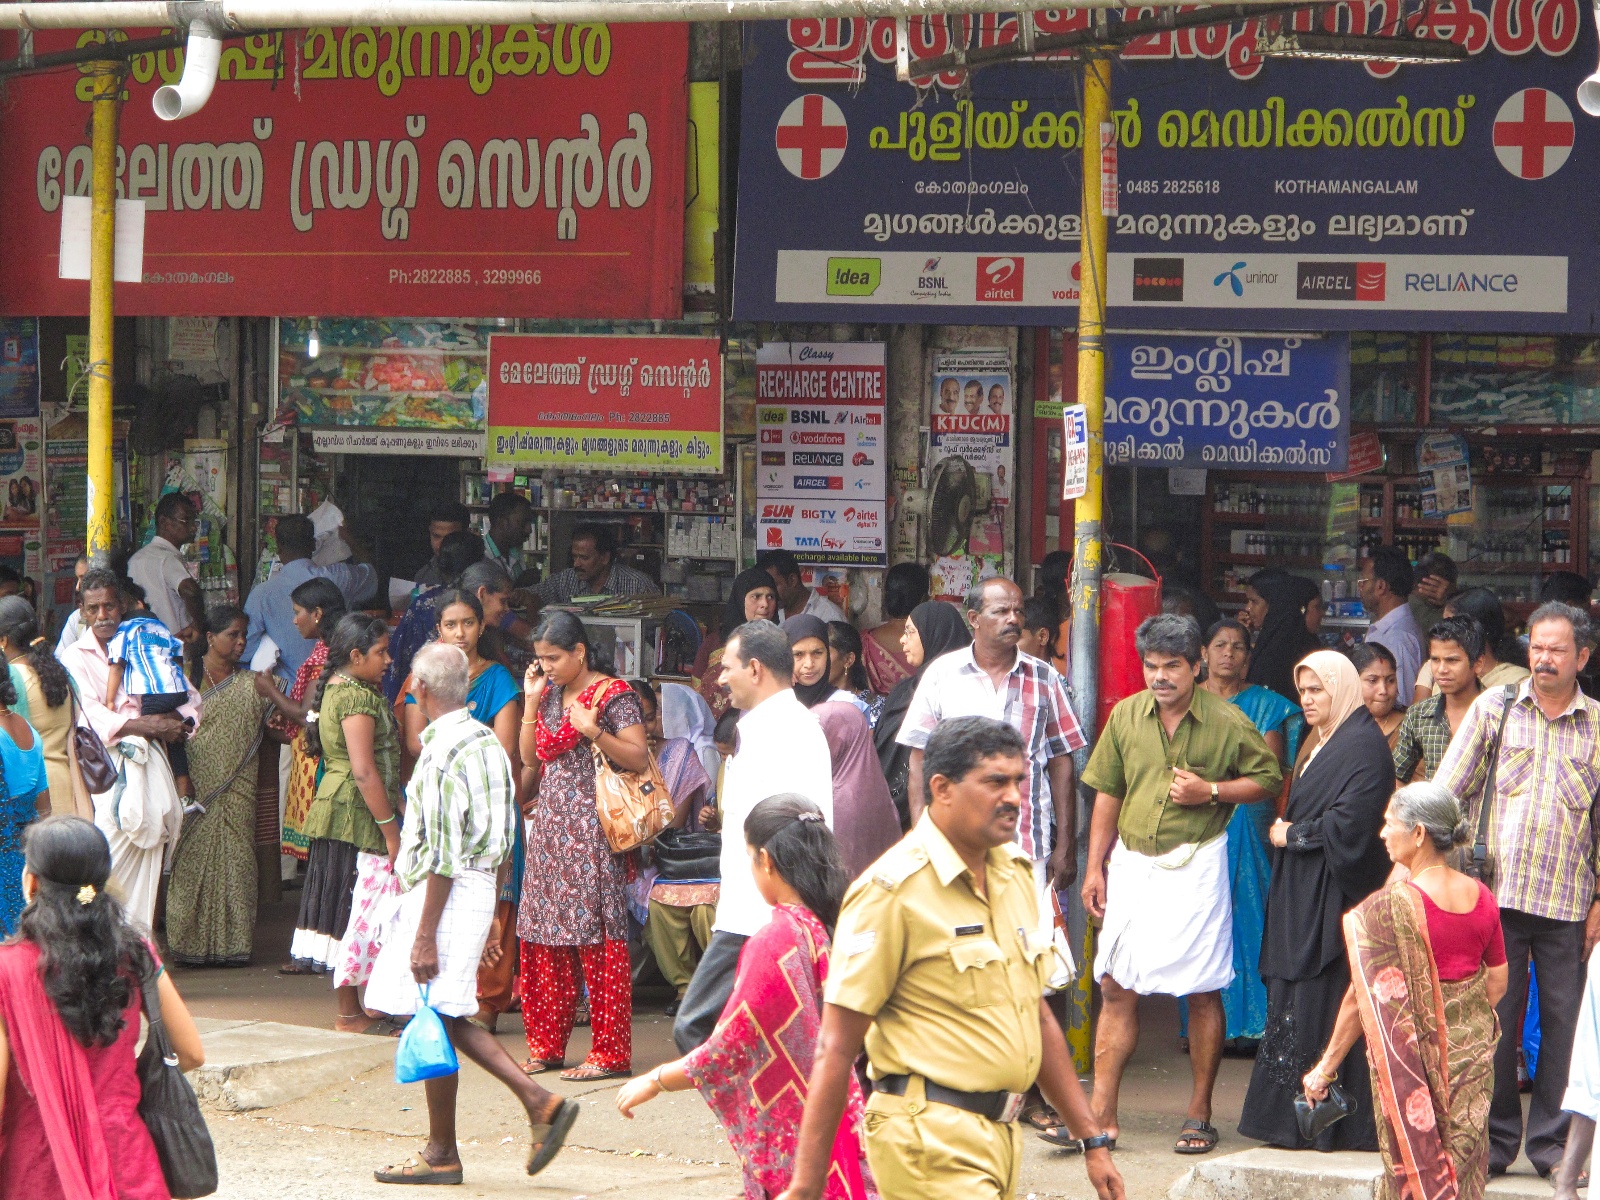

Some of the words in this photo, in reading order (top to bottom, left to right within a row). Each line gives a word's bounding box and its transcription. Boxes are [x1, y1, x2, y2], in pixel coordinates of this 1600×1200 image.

[1156, 94, 1476, 148] മെഡിക്കൽസ്
[914, 181, 1029, 195] കോതമംഗലം
[1127, 180, 1159, 195] 0485
[1163, 180, 1220, 195] 2825618
[1274, 180, 1419, 195] KOTHAMANGALAM
[1116, 213, 1316, 242] മരുന്നുകളും
[1328, 208, 1475, 242] ലഭ്യമാണ്
[483, 269, 542, 285] 3299966
[918, 276, 949, 290] BSNL
[1244, 270, 1279, 285] uninor
[1301, 275, 1352, 291] AIRCEL
[984, 287, 1015, 300] airtel
[1052, 287, 1081, 300] voda
[798, 346, 835, 362] Classy
[1131, 336, 1302, 393] ഇംഗ്ലീഷ്
[759, 370, 827, 399] RECHARGE
[830, 371, 882, 399] CENTRE
[608, 412, 626, 423] Ph:
[791, 410, 830, 424] BSNL
[937, 415, 1006, 432] KTUC(M)
[803, 432, 842, 444] vodafone
[1104, 435, 1185, 465] ുളിക്കൽ
[796, 478, 827, 488] AIRCEL
[762, 504, 795, 518] SUN
[857, 511, 878, 521] airtel
[795, 536, 820, 547] TATA
[794, 552, 826, 563] recharge
[828, 553, 860, 563] available
[861, 554, 878, 563] here
